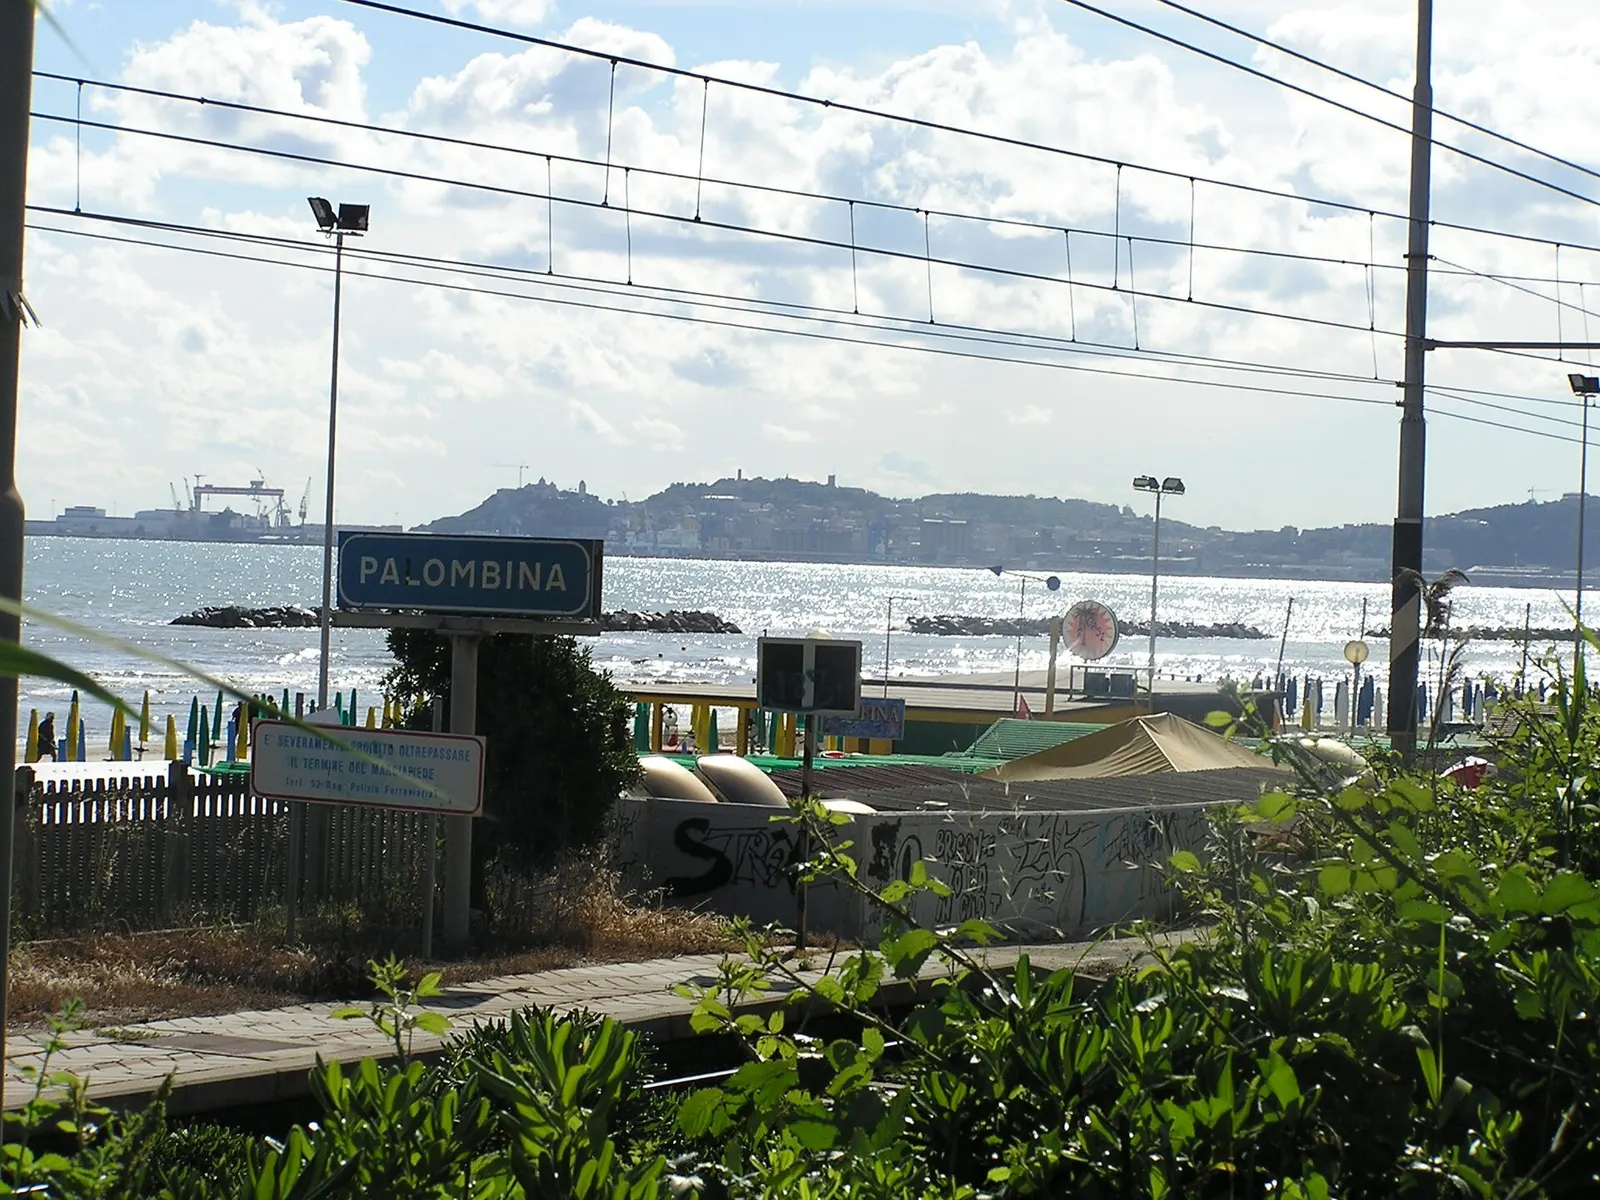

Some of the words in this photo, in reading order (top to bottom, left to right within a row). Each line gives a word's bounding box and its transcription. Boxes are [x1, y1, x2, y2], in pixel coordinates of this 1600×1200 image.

[359, 555, 568, 593] PALOMBINA
[399, 744, 471, 762] OLTREPASSARE
[348, 760, 367, 774] DEL
